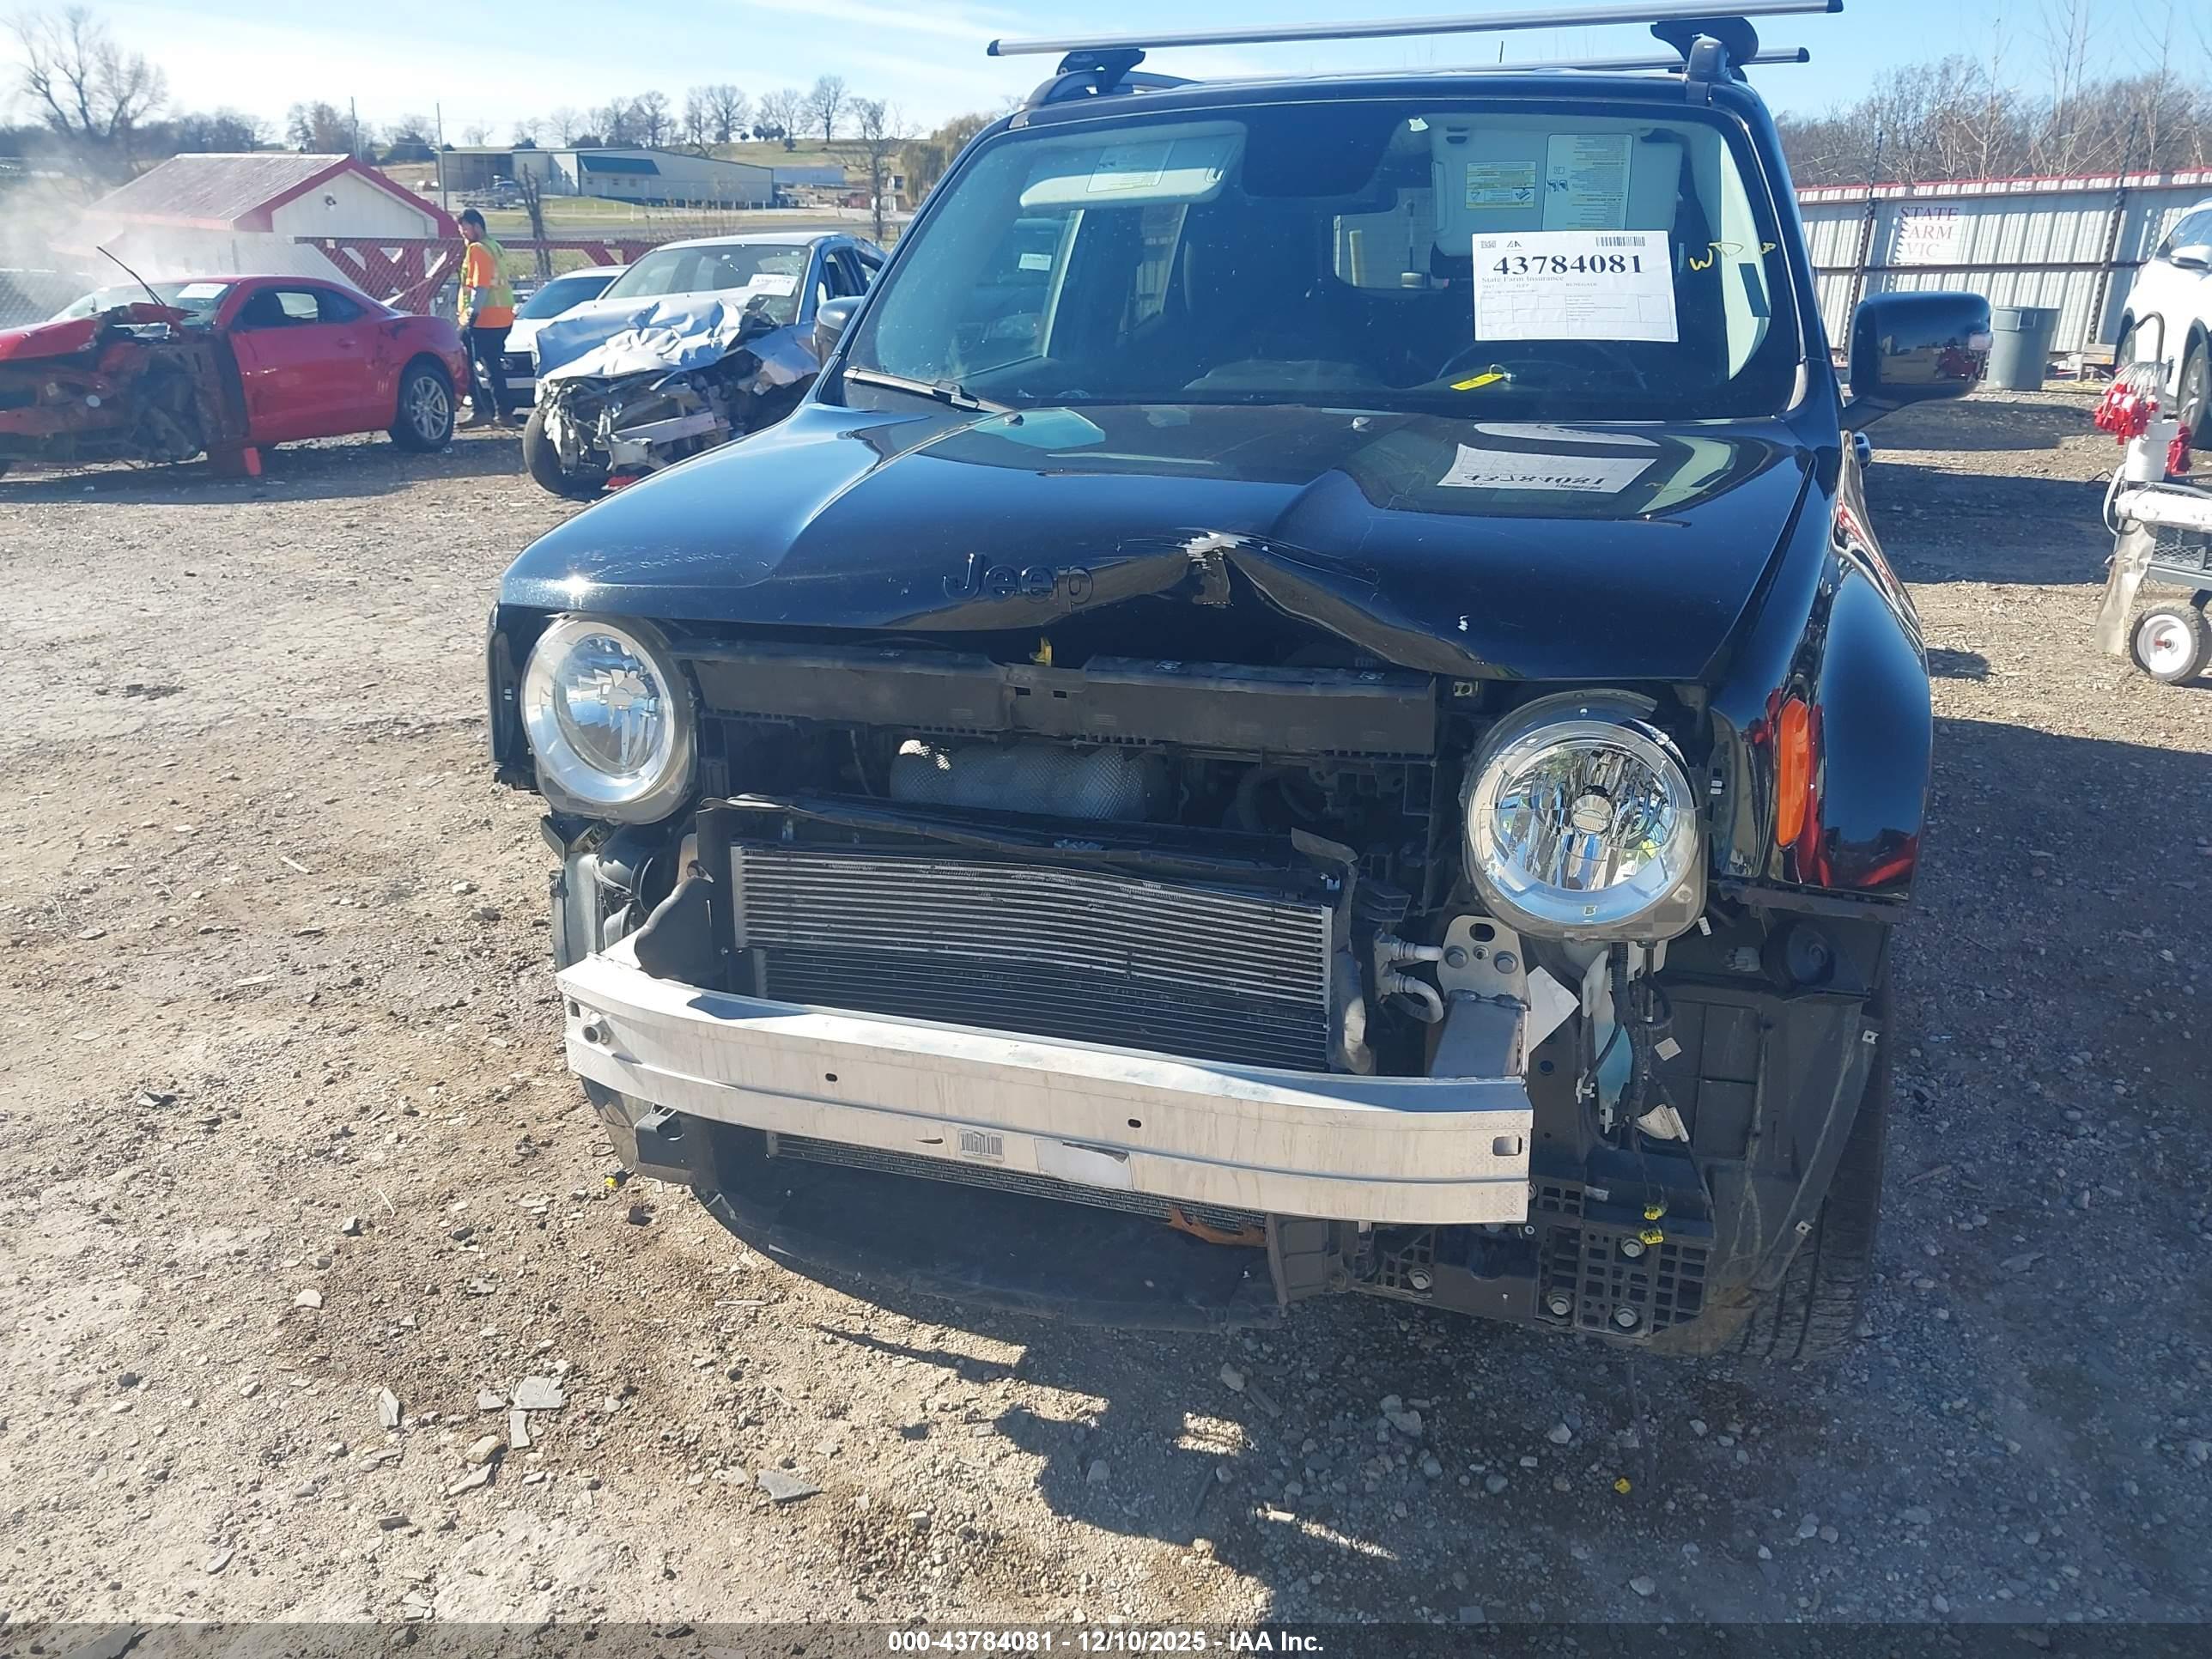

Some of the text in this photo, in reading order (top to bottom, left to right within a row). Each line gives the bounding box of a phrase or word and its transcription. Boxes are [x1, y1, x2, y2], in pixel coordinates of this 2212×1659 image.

[1900, 206, 1959, 222] STATE
[1905, 225, 1954, 240] ARM
[1493, 254, 1646, 275] 43784081
[943, 552, 1093, 614] Jeep
